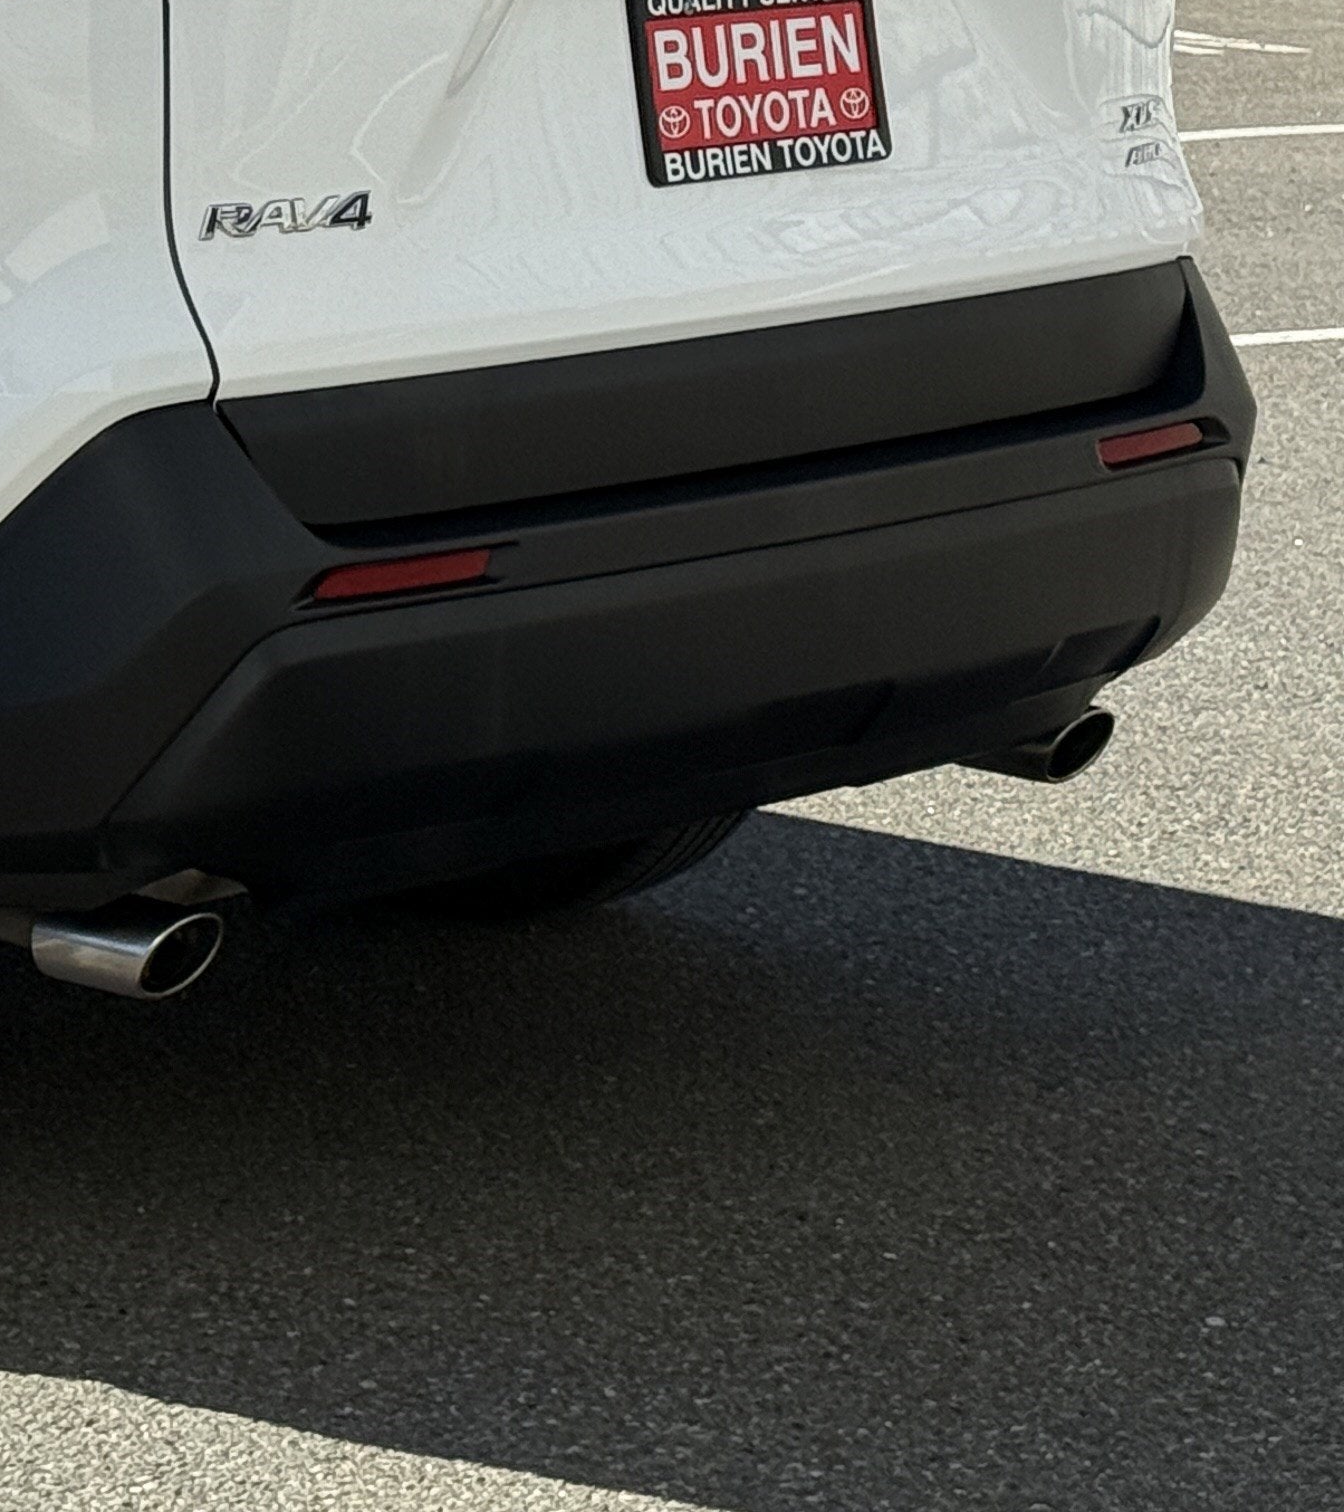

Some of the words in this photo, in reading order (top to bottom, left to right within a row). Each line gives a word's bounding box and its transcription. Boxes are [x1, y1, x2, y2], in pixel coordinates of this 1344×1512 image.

[653, 13, 862, 92] BURIEN
[693, 88, 838, 140] TOYOTA
[663, 142, 773, 183] BURIEN
[775, 129, 887, 169] TOYOTA
[198, 190, 374, 241] RAV4
